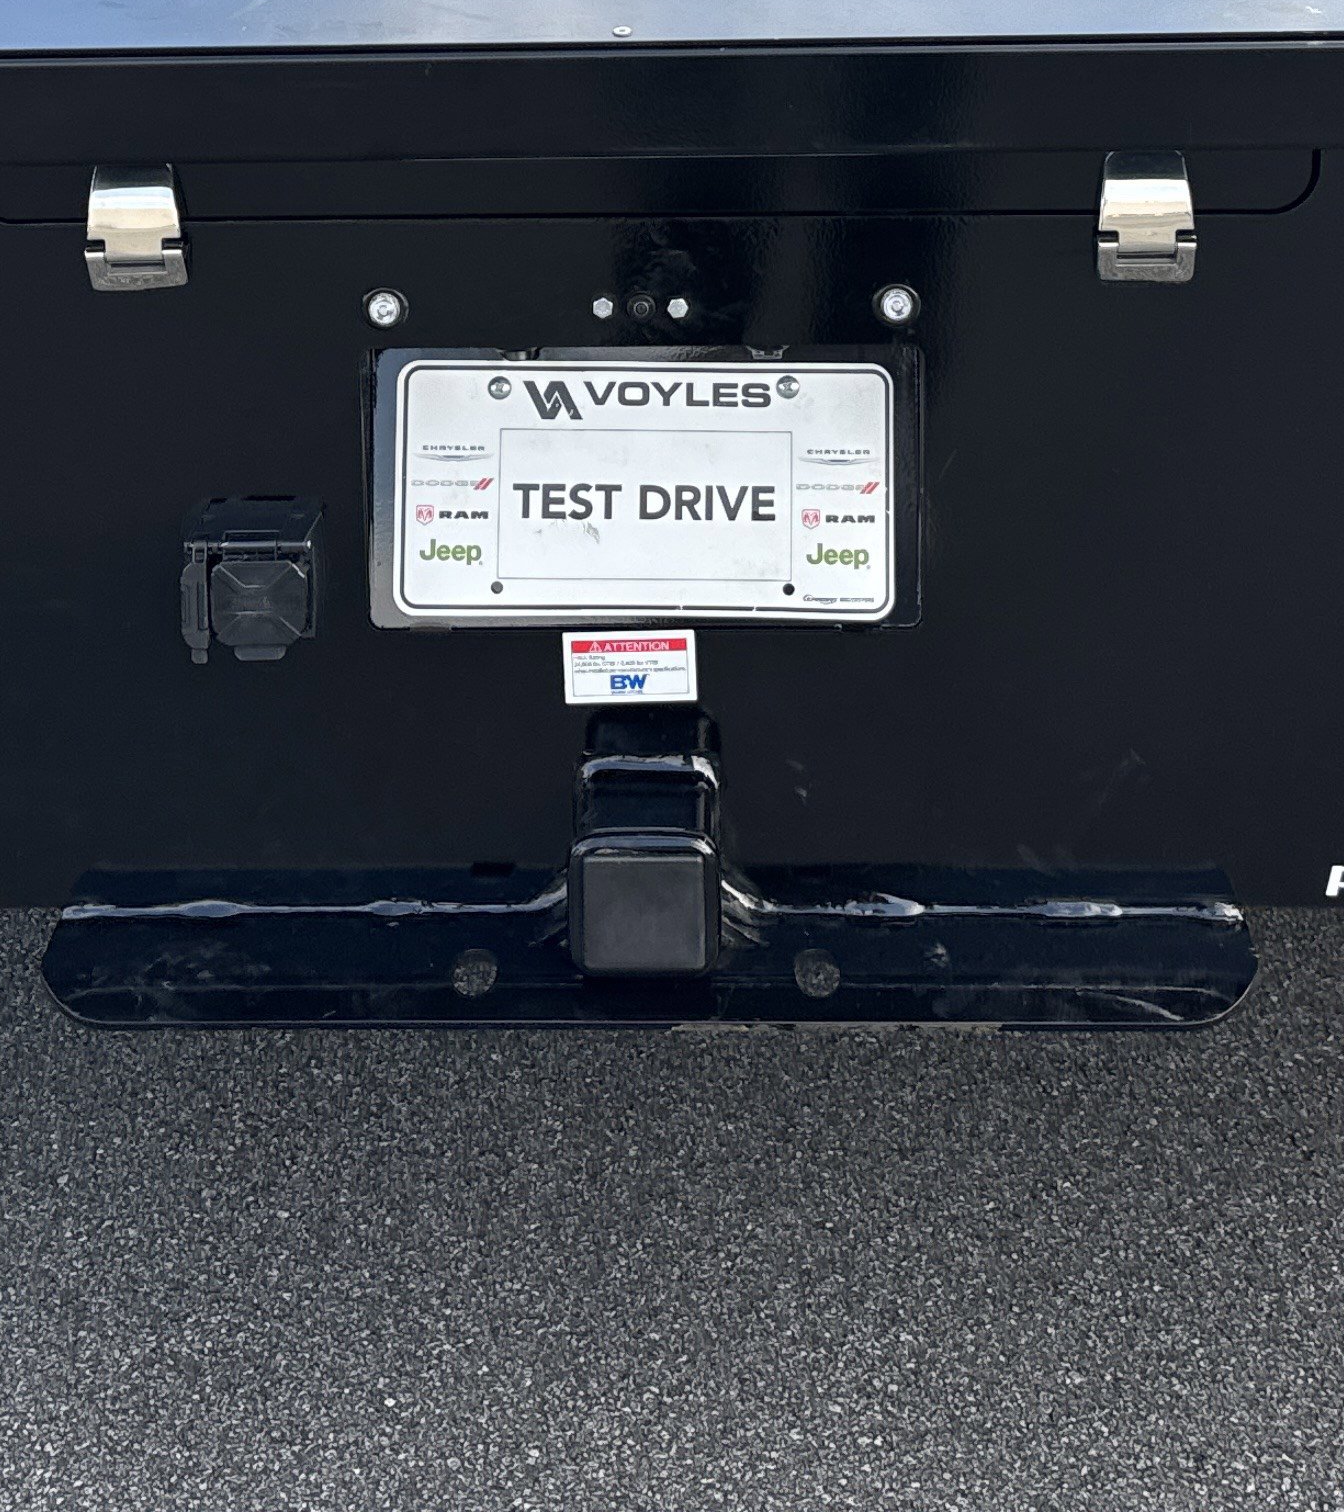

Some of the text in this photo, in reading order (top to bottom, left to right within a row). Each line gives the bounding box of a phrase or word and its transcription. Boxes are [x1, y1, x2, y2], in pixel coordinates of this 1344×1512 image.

[584, 381, 772, 408] VOYLES
[438, 510, 489, 519] RAM
[513, 483, 776, 521] TEST DRIVE
[825, 514, 876, 523] RAM
[419, 538, 482, 566] Jeep
[806, 542, 870, 570] Jeep
[604, 641, 670, 652] ATTENTION
